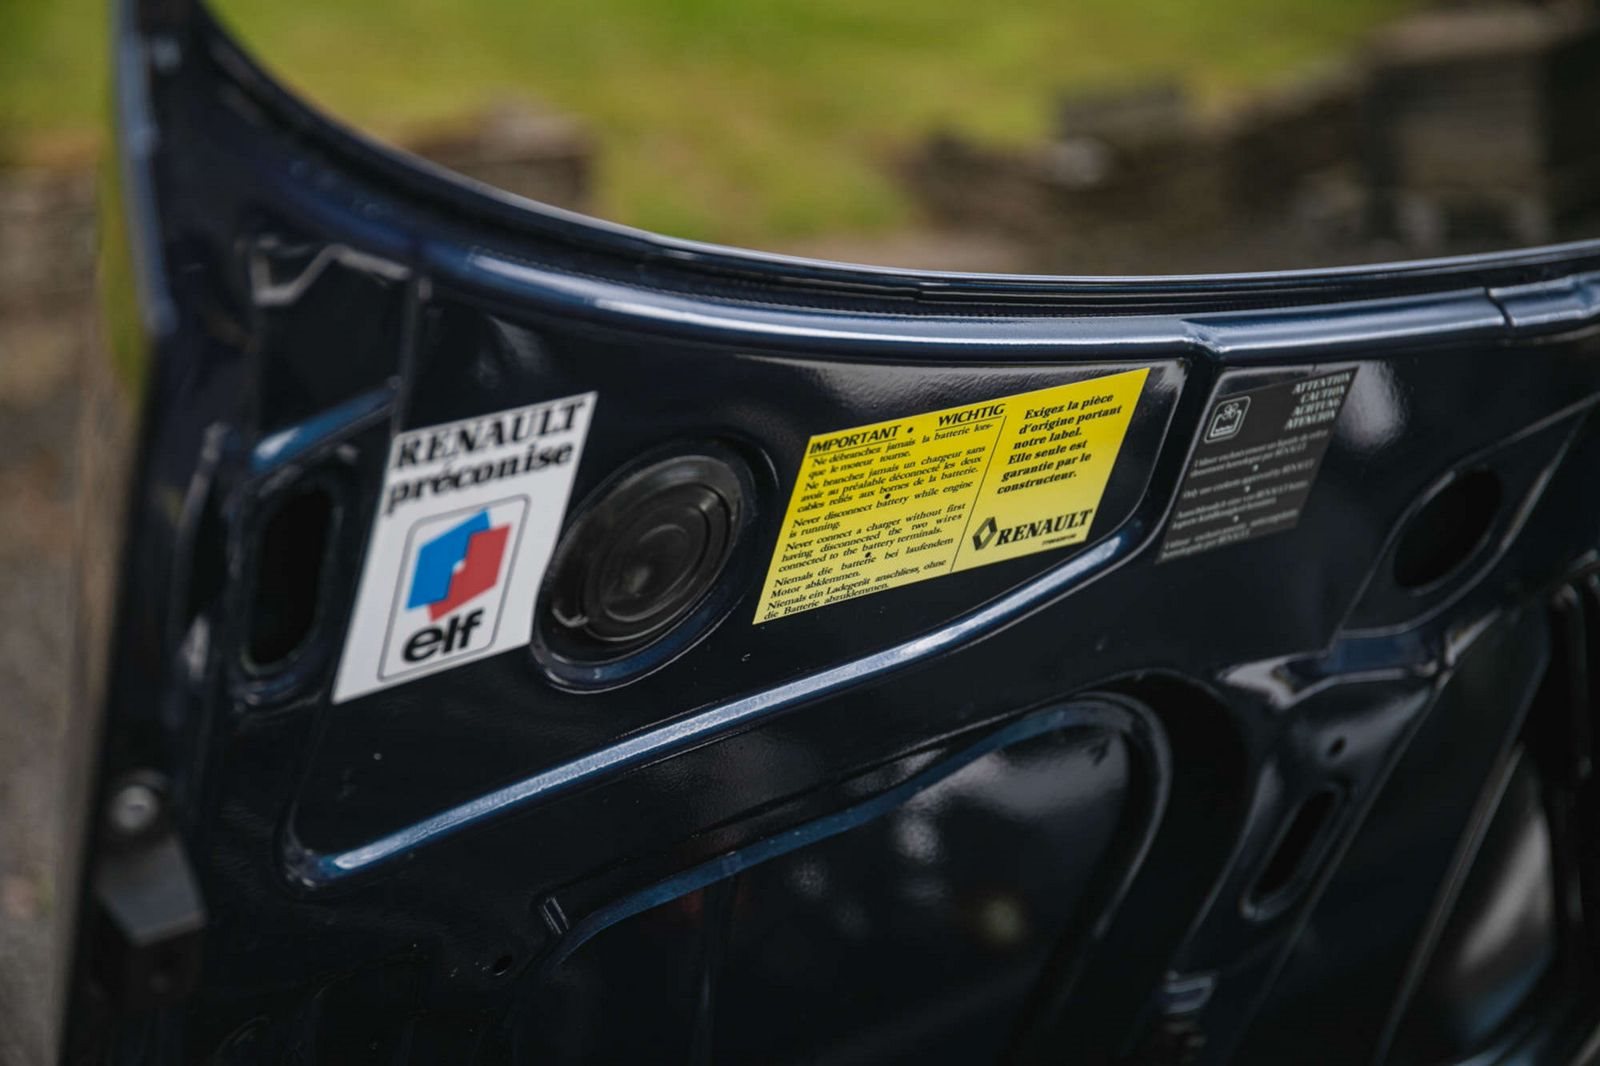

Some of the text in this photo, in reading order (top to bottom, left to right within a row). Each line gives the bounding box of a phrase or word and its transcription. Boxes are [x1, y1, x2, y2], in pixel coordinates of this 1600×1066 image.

[939, 403, 1006, 426] WICHTIG
[1018, 405, 1122, 435] d'origine portant
[1024, 393, 1114, 420] Exigez la pièce
[394, 401, 586, 470] RENAULT
[809, 425, 901, 454] IMPORTANT
[812, 458, 827, 467] Ne
[886, 439, 915, 452] jamais
[921, 435, 930, 444] la
[934, 427, 970, 440] batterie
[974, 423, 993, 432] lors-
[1007, 439, 1088, 465] Elle seule est
[1013, 427, 1082, 450] notre label.
[386, 441, 574, 517] préconise
[800, 491, 824, 502] avoir
[827, 488, 839, 496] au
[943, 461, 955, 470] les
[960, 456, 982, 466] deux
[805, 446, 986, 491] Ne branchez jamais un chargeur sans
[808, 450, 910, 480] que le moteur tourne.
[996, 470, 1077, 495] constructeur.
[1001, 453, 1092, 482] garantie par le
[792, 481, 973, 528] Never disconnect battery while engine
[797, 502, 825, 513] cables
[858, 490, 875, 499] aux
[879, 482, 909, 494] bornes
[913, 477, 924, 486] de
[928, 474, 937, 483] la
[941, 466, 978, 480] batterie.
[781, 513, 962, 562] having disconnected the two wires
[785, 540, 813, 552] Never
[816, 530, 852, 544] connect
[866, 518, 901, 532] charger
[905, 509, 942, 522] without
[946, 503, 966, 513] first
[789, 530, 797, 538] is
[994, 508, 1093, 547] RENAULT
[774, 538, 954, 587] Niemals die batterie bei laufendem
[778, 527, 942, 572] connected to the battery terminals.
[767, 594, 806, 610] Niemals
[808, 590, 823, 599] ein
[923, 560, 946, 570] ohne
[770, 571, 861, 599] Motor abklemmen.
[764, 610, 778, 620] die
[783, 600, 820, 615] Batterie
[402, 607, 485, 663] elf
